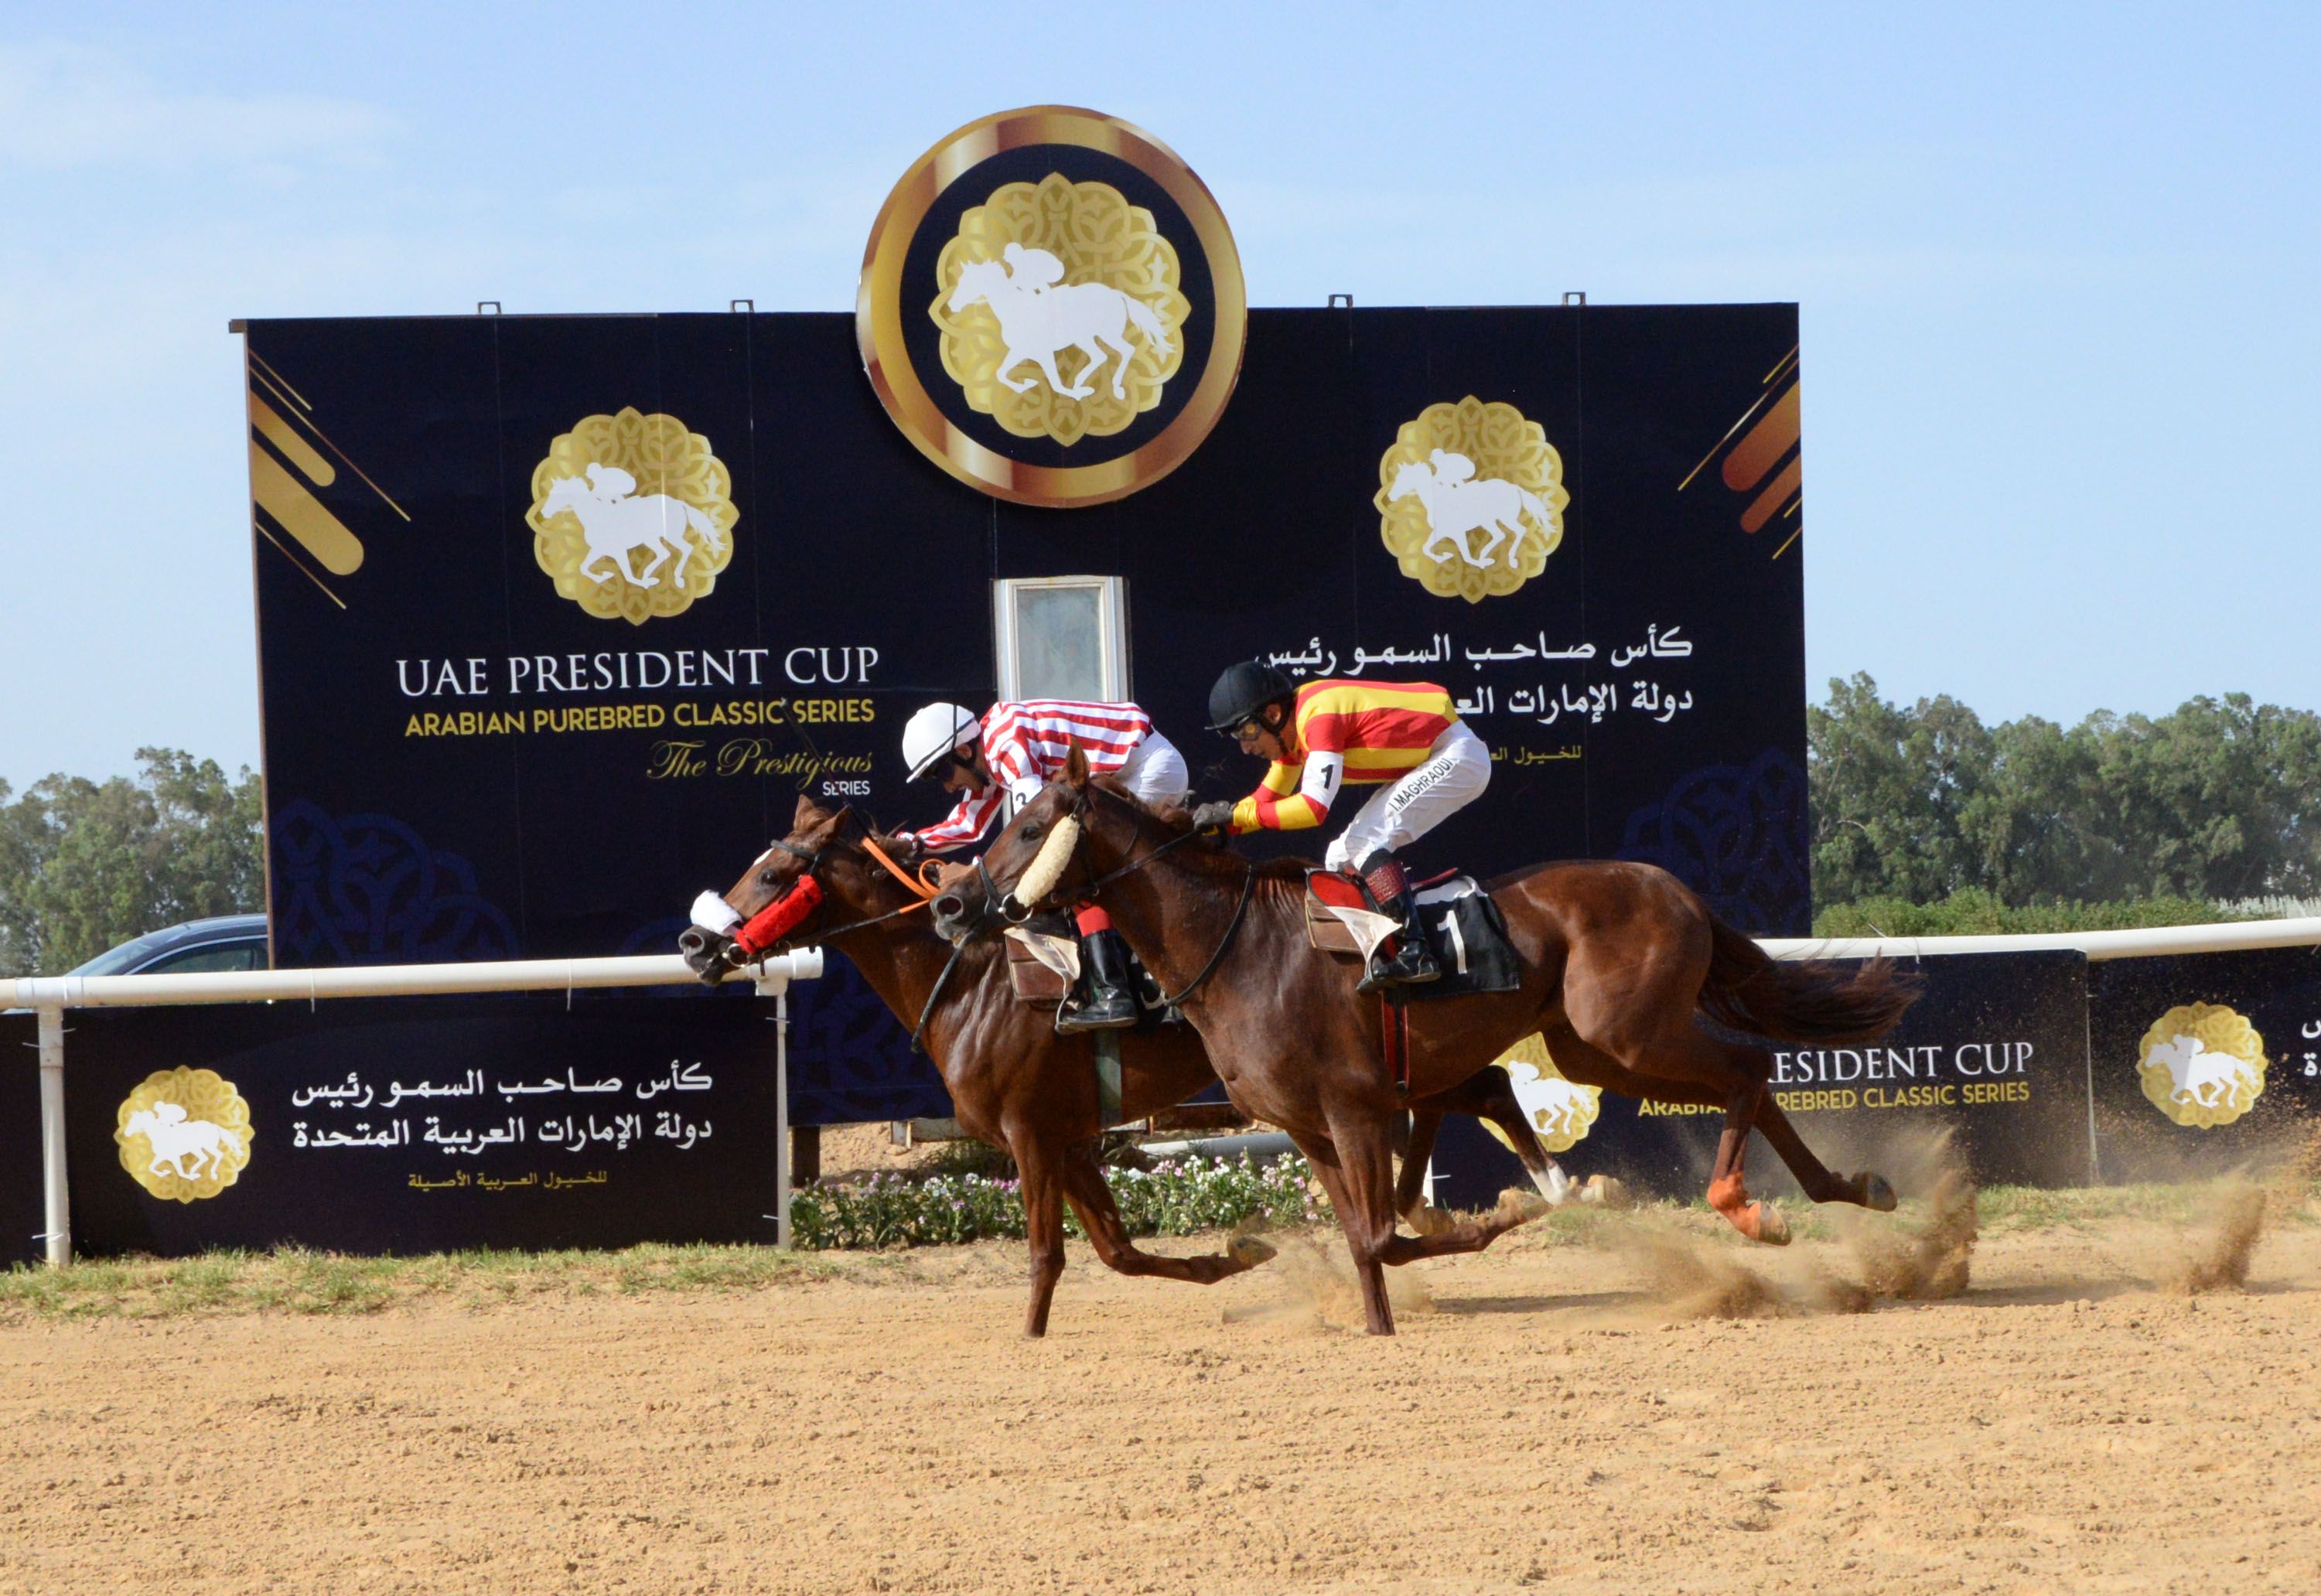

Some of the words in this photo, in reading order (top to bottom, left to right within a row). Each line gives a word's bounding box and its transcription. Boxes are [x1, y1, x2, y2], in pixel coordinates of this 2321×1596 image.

[1343, 633, 1451, 676] السمو
[1465, 630, 1596, 671] صاحب
[1610, 622, 1693, 667] كأس
[395, 658, 489, 697] UAE
[507, 649, 769, 694] PRESIDENT
[784, 646, 879, 684] CUP
[404, 711, 525, 737] ARABIAN
[533, 704, 665, 732] PUREBRED
[673, 701, 783, 727] CLASSIC
[794, 698, 875, 723] SERIES
[1508, 682, 1617, 725] الإمارات
[1631, 680, 1693, 723] دولة
[647, 740, 707, 779] The
[716, 738, 873, 791] Prestigious
[1514, 744, 1582, 766] للخيول
[822, 779, 871, 796] SERIES
[1320, 764, 1334, 790] 1
[1388, 757, 1454, 812] I.MAGHRAOUI
[1436, 909, 1468, 975] 1
[636, 1059, 713, 1100] كأس
[1766, 1045, 1943, 1083] ESIDENT
[1954, 1042, 2033, 1076] CUP
[292, 1072, 374, 1109] رئيس
[379, 1069, 484, 1108] السمو
[497, 1066, 623, 1103] صاحب
[1772, 1089, 1856, 1112] REBRED
[1862, 1084, 1957, 1109] CLASSIC
[1961, 1080, 2030, 1104] SERIES
[292, 1118, 410, 1149] المتحدة
[423, 1115, 525, 1155] العربية
[538, 1113, 642, 1152] الإمارات
[654, 1111, 712, 1150] دولة
[408, 1169, 471, 1193] الأصيلة
[476, 1171, 538, 1192] العربية
[544, 1170, 608, 1190] للخيول
